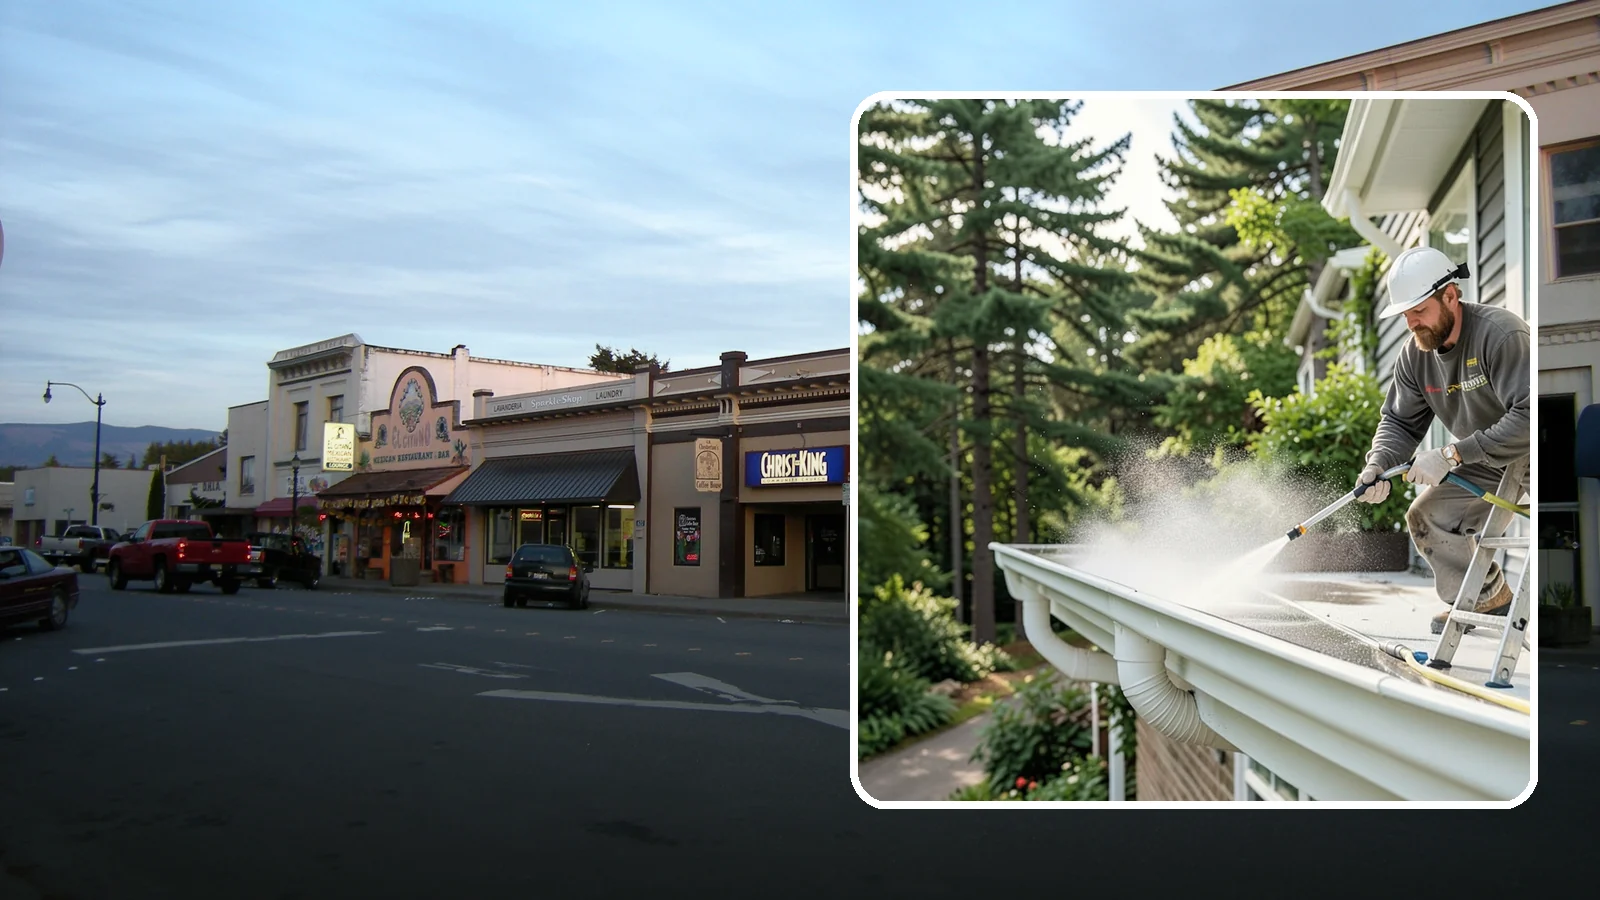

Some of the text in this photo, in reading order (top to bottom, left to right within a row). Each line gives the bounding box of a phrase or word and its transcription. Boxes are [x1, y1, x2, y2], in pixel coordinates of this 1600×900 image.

[493, 402, 522, 412] LAVANDERIA
[562, 395, 582, 404] Shop
[596, 389, 624, 400] LAUNDRY
[391, 425, 402, 449] EL
[373, 455, 396, 464] MEXICAN
[397, 451, 434, 462] RESTAURANT
[438, 450, 450, 459] BAR
